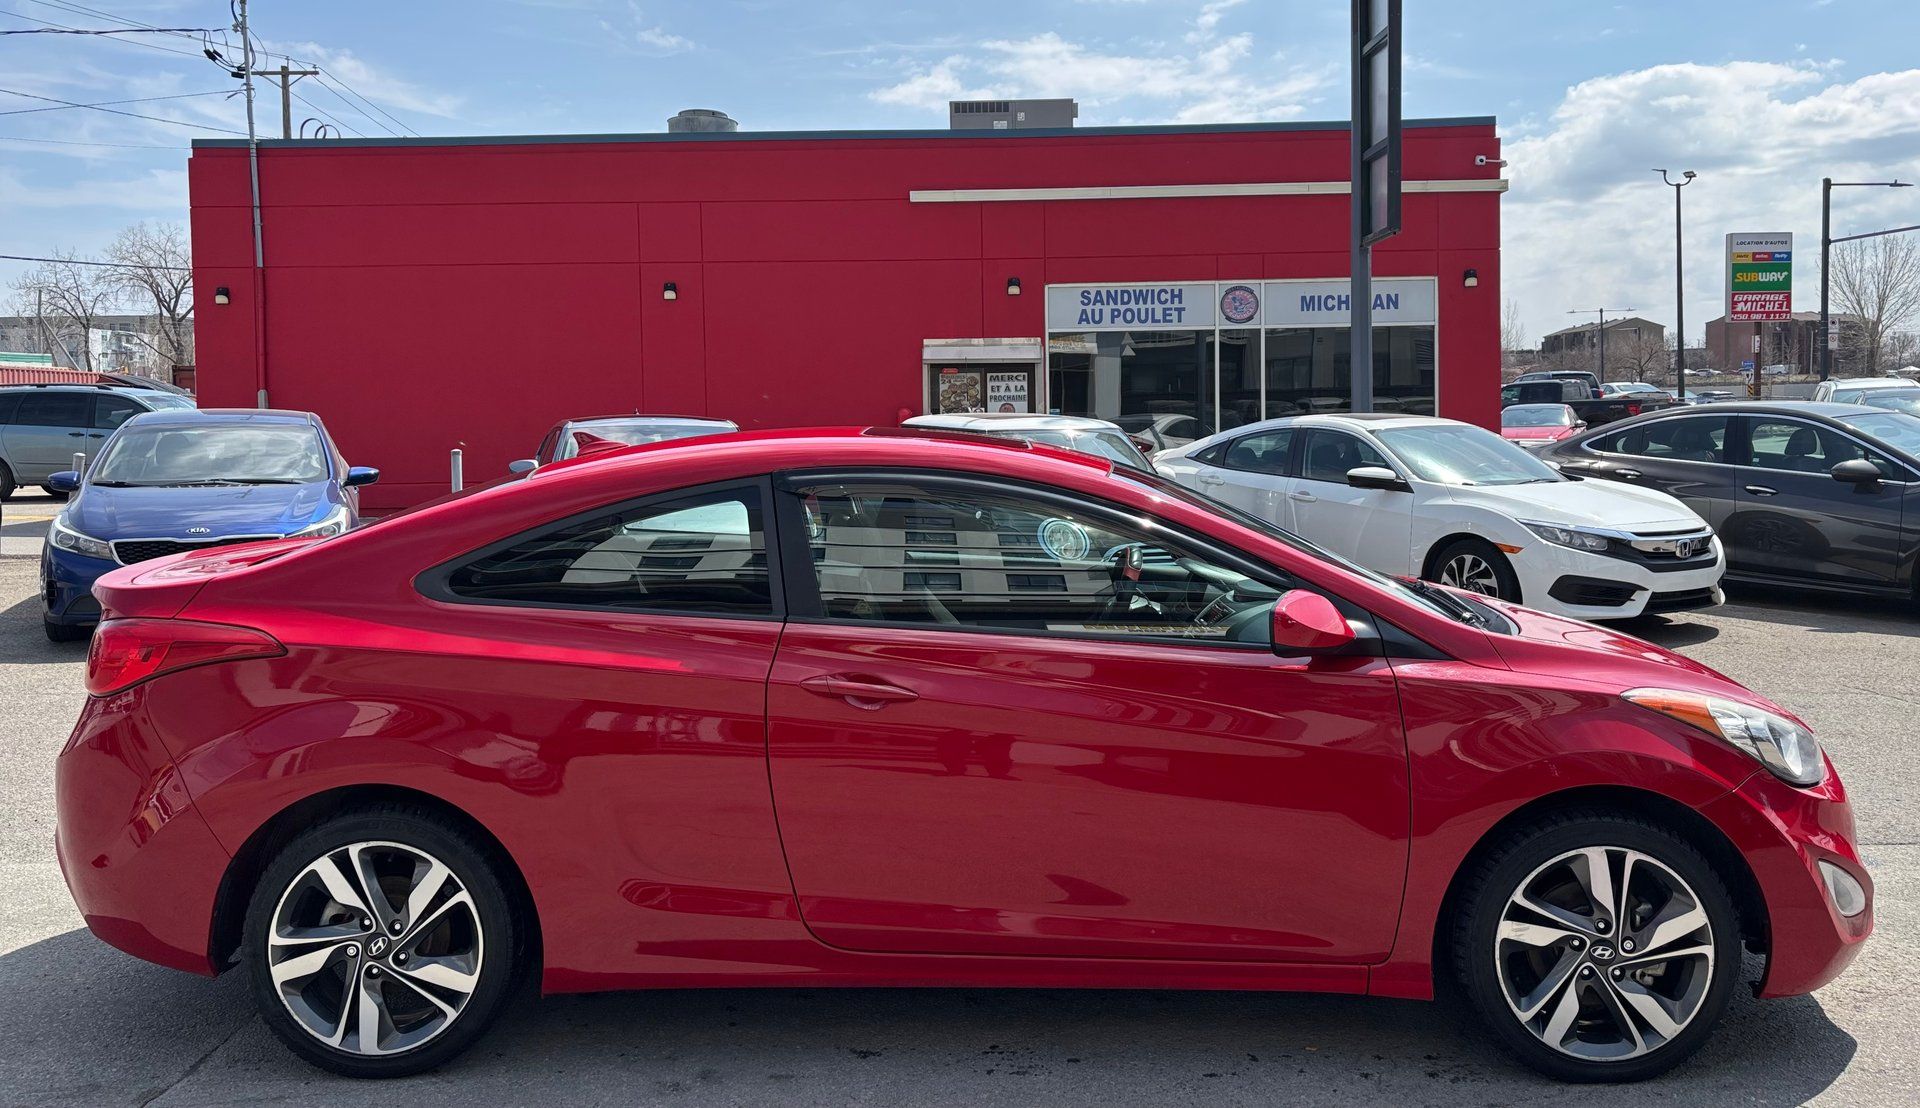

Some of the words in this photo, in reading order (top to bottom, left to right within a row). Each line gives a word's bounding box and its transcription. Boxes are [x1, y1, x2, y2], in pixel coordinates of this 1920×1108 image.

[1735, 271, 1788, 282] SUBWAY
[1080, 288, 1183, 306] SANDWICH
[1300, 293, 1399, 312] MICHAN
[1735, 301, 1790, 311] MICHEL
[1078, 308, 1104, 325] AU
[1110, 307, 1186, 324] POULET
[989, 374, 1026, 382] MERCI
[991, 385, 1002, 393] ET
[1004, 383, 1011, 393] À
[1014, 385, 1025, 393] LA
[989, 394, 1027, 403] PROCHAINE
